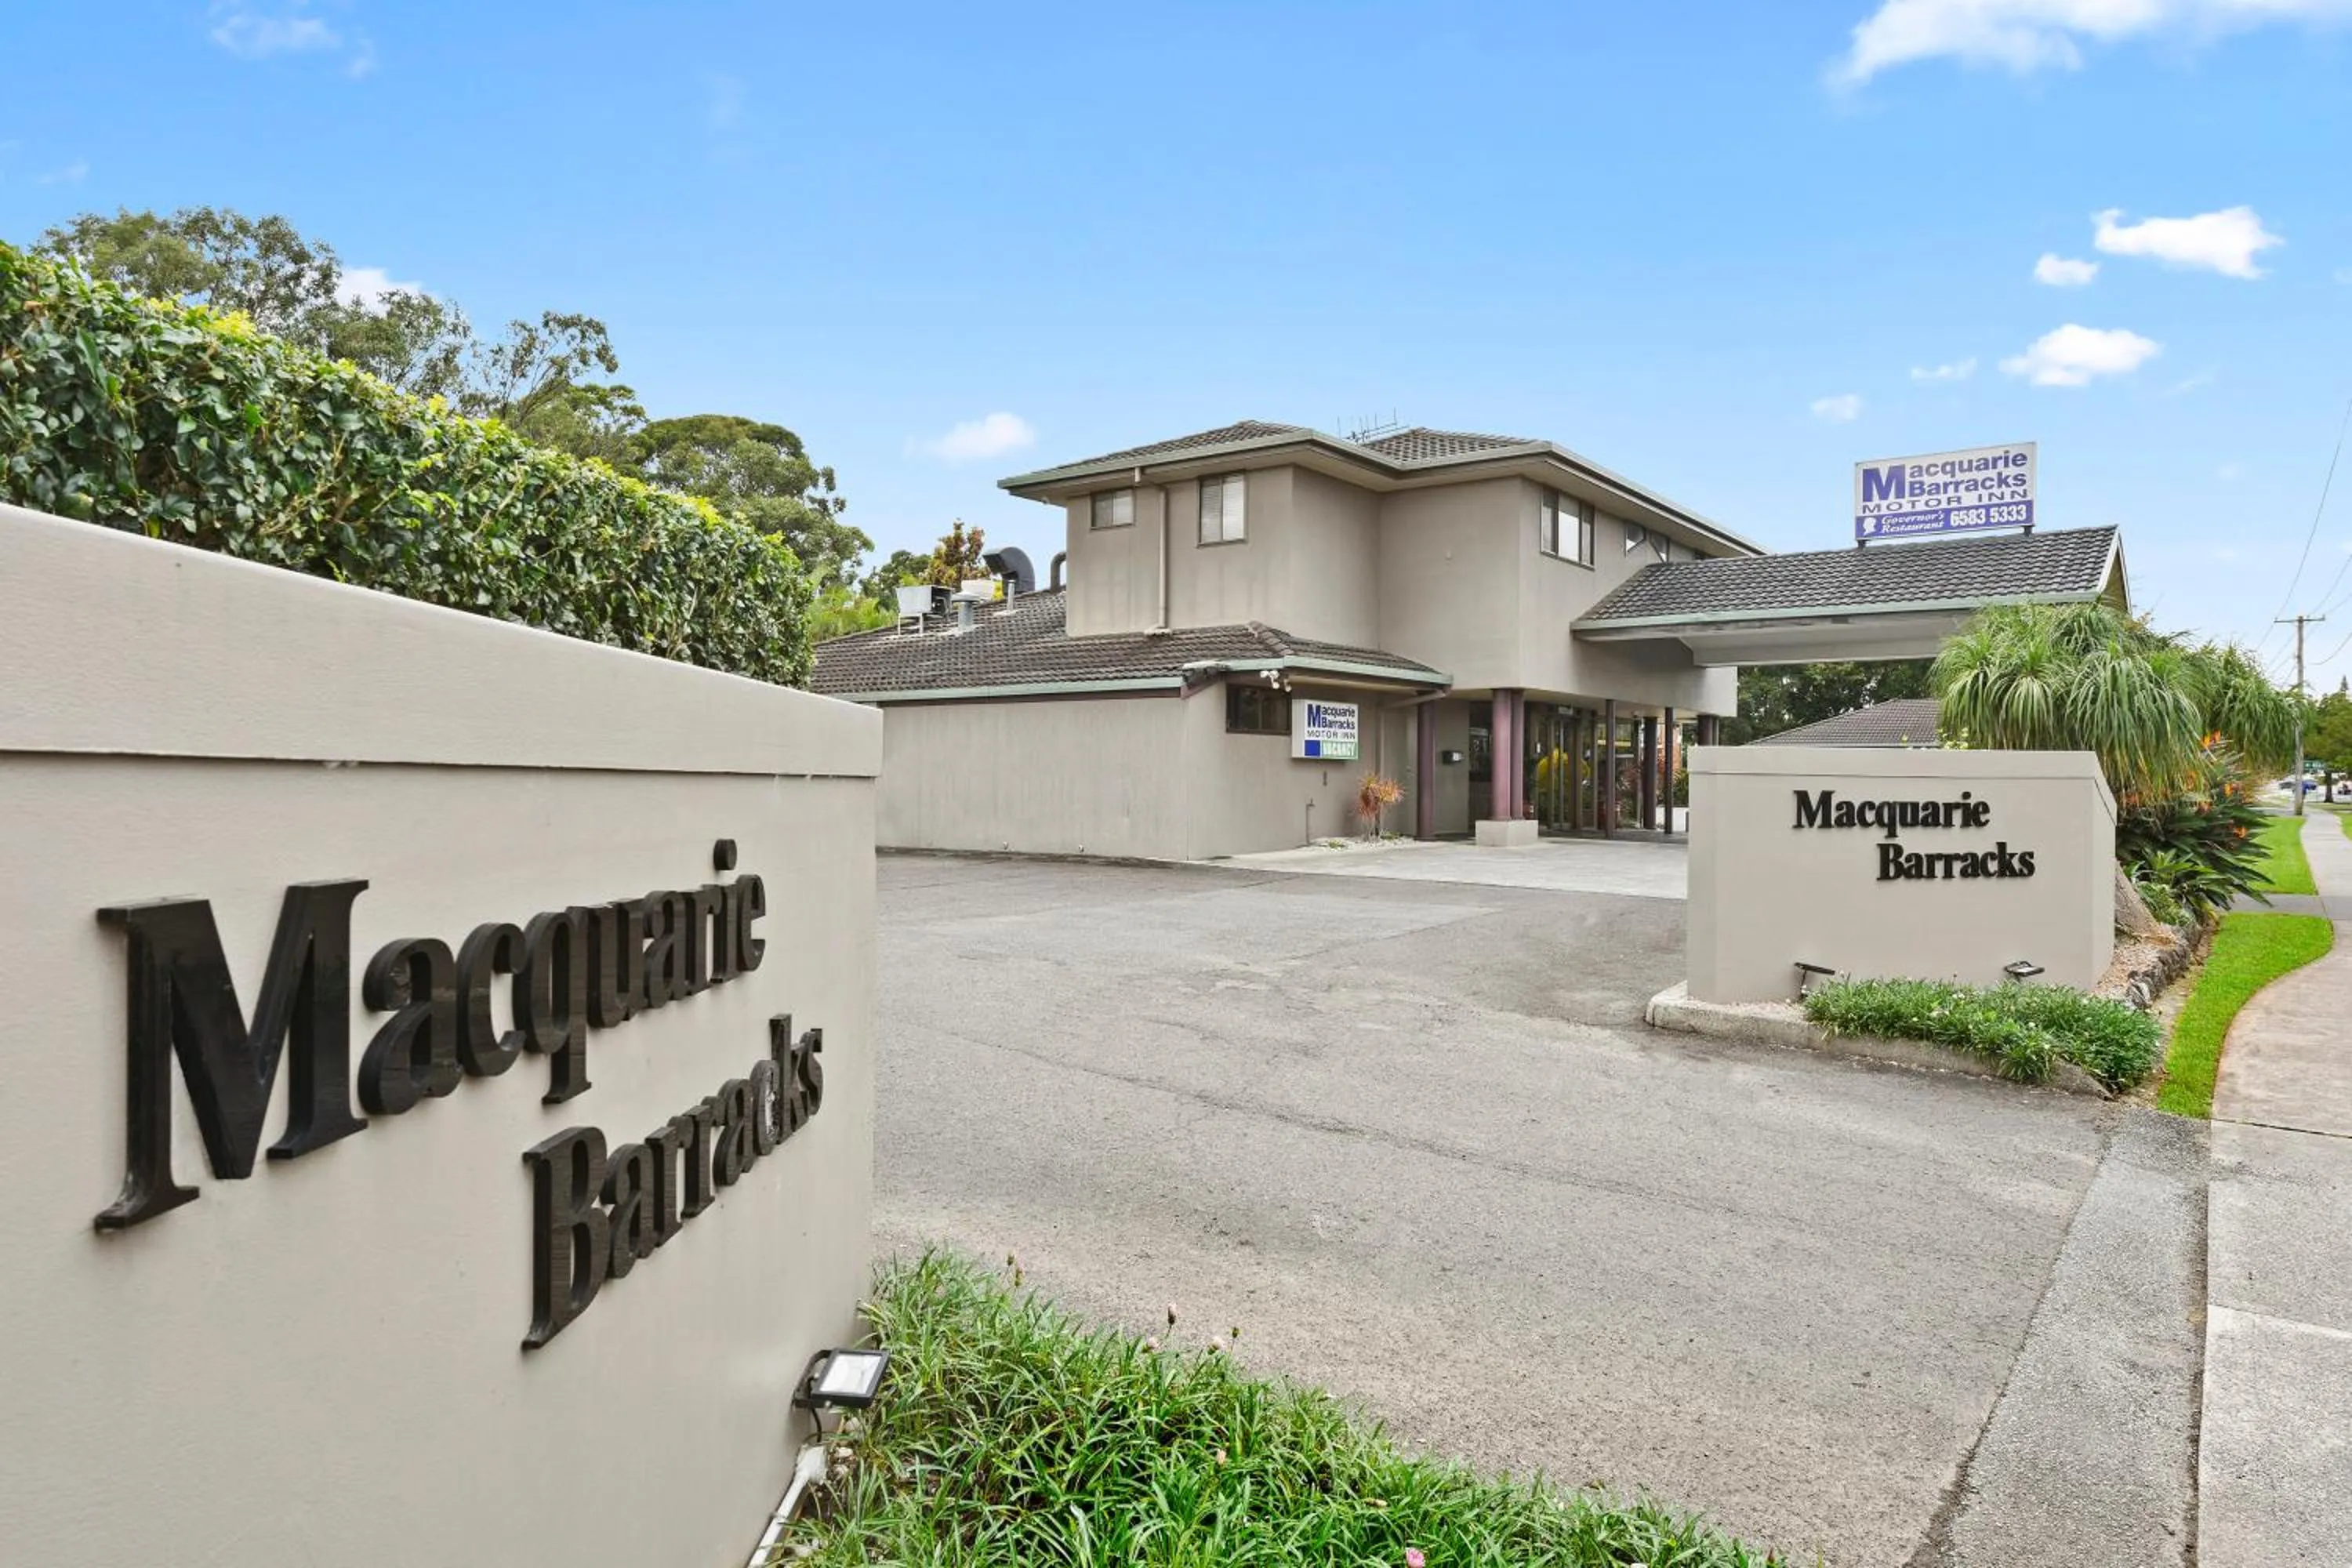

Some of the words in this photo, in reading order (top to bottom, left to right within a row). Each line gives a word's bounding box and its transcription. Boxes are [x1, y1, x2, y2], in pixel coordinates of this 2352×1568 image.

[1862, 449, 2027, 503] Macquarie
[1908, 471, 2027, 498] Barracks
[1861, 495, 1962, 514] MOTOR
[1977, 488, 2028, 502] INN
[1881, 511, 1945, 524] Governor's
[1881, 520, 1944, 534] Restaurant
[1950, 509, 1986, 527] 6583
[1989, 504, 2027, 523] 5333
[1307, 704, 1356, 728] Macquarie
[1321, 717, 1356, 730] Barracks
[1307, 730, 1338, 739] MOTOR
[1792, 789, 1991, 838] Macquarie
[1876, 841, 2036, 880] Barracks
[95, 838, 766, 1232] Macquarie
[521, 1013, 823, 1351] Barracks
